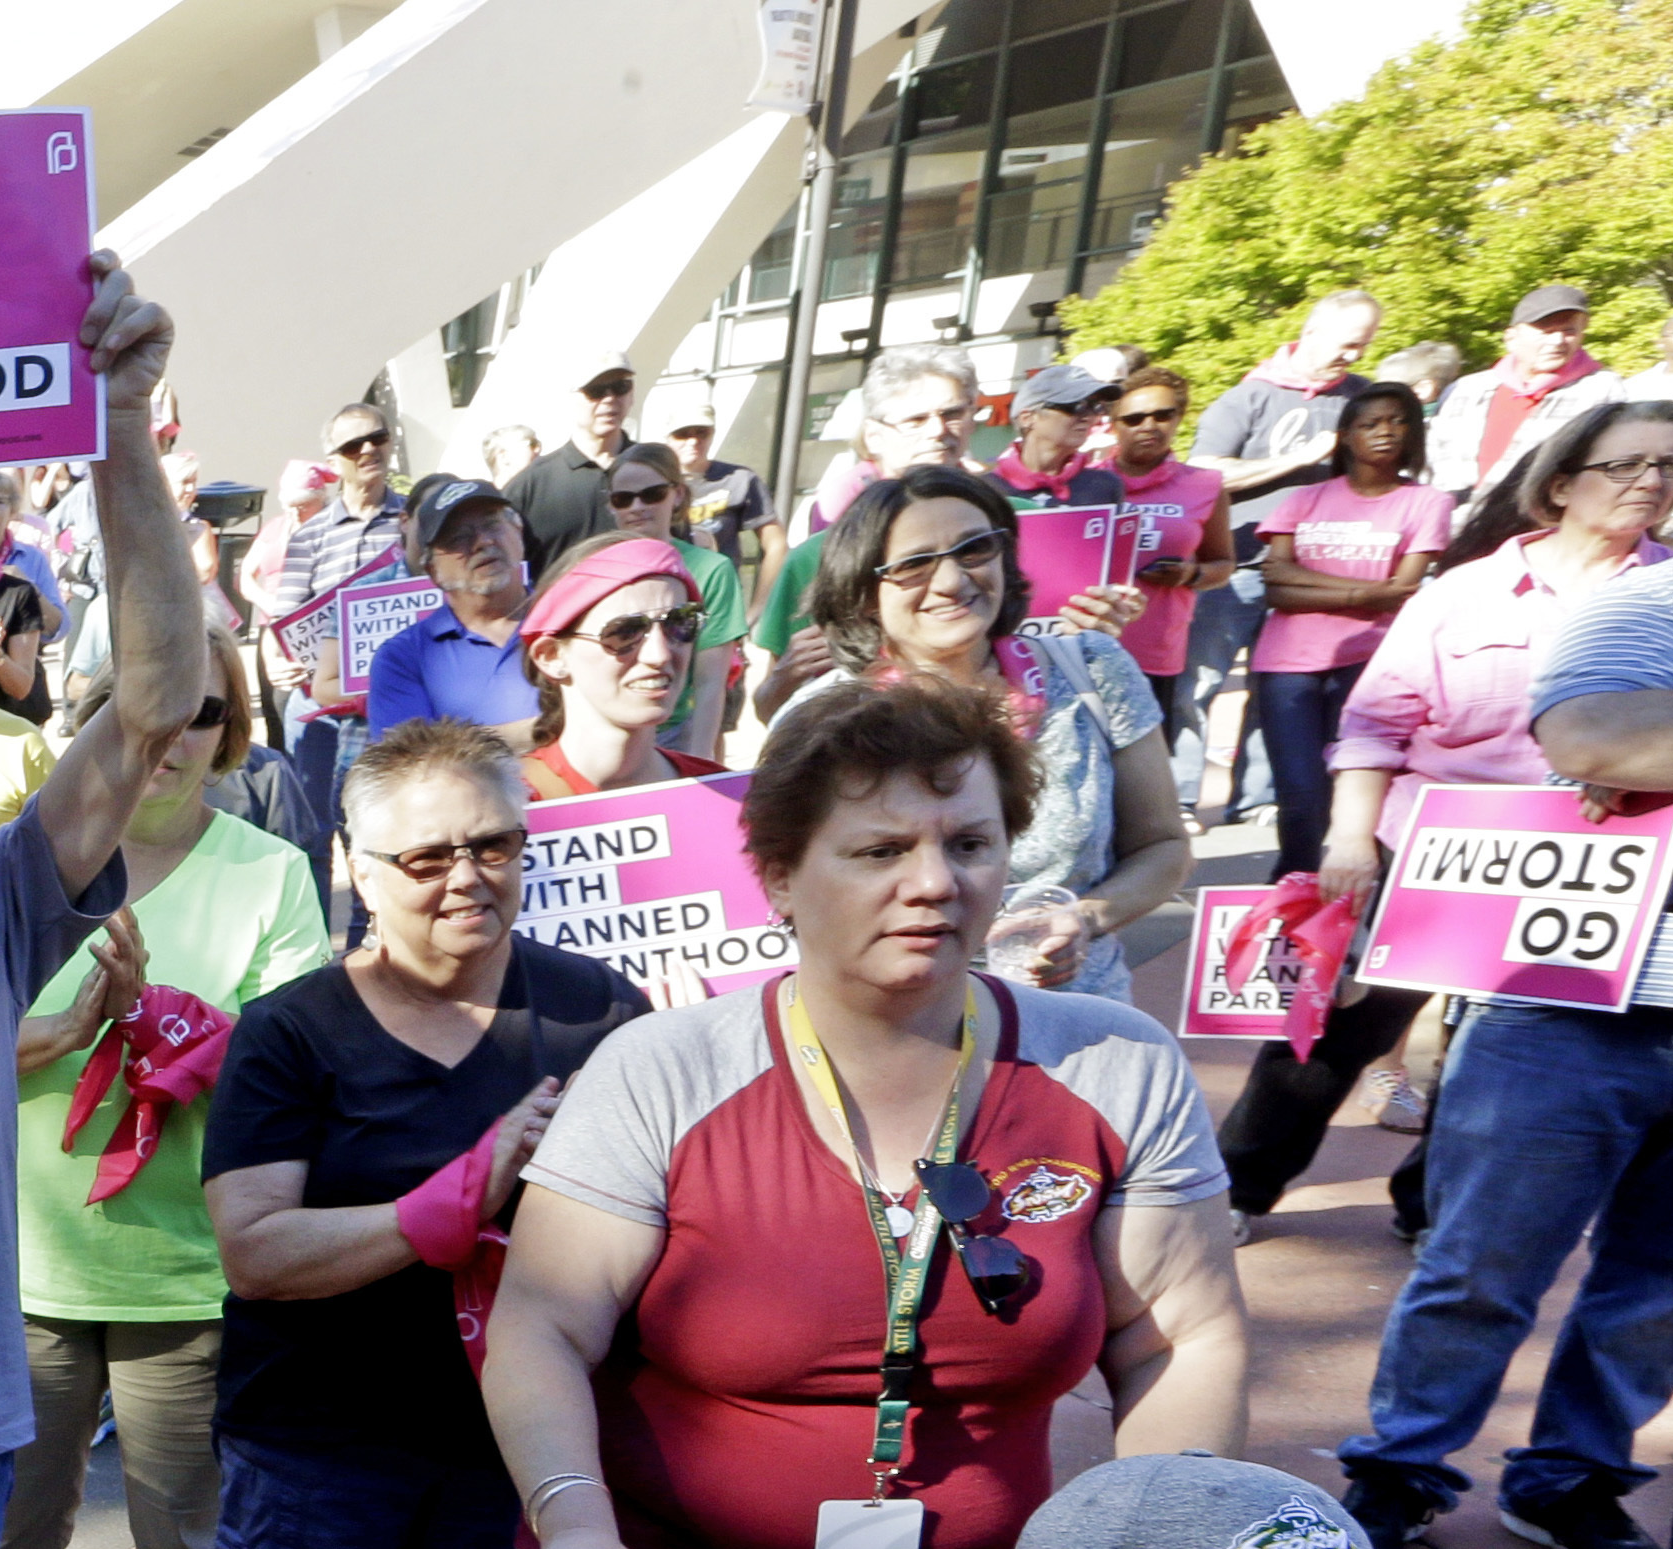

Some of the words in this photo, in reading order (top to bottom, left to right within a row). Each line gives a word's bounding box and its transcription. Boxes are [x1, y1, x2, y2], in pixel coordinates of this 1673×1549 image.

[365, 593, 438, 615] STAND
[353, 615, 410, 636] WITH
[1414, 834, 1646, 896] STORM!
[1520, 907, 1620, 963] GO
